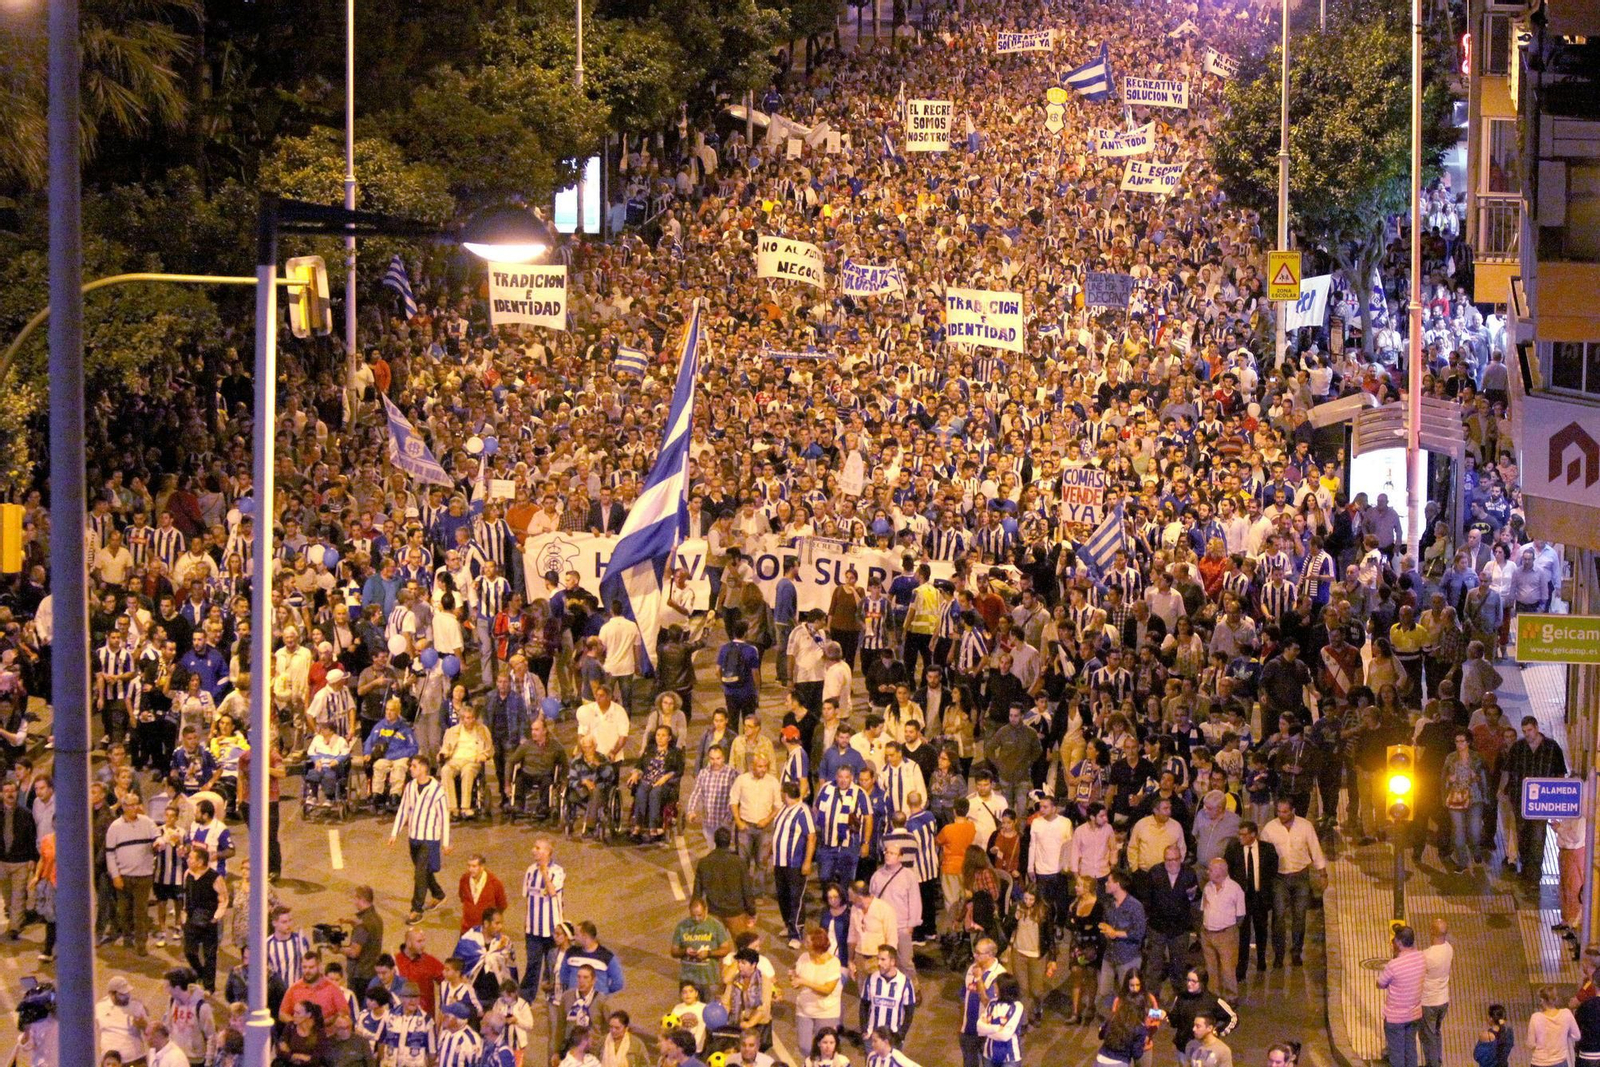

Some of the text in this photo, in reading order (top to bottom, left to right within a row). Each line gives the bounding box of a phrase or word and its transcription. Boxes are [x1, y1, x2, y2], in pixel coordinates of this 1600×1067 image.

[1039, 39, 1050, 48] YA
[1126, 77, 1183, 93] RECREATIVO
[1126, 89, 1183, 104] SOLUCION YA
[909, 103, 951, 116] EL RECRE
[913, 116, 946, 129] SOMOS
[1125, 136, 1146, 148] TODO
[1131, 162, 1142, 174] EL
[761, 242, 778, 252] NO
[784, 245, 799, 255] AL
[493, 272, 565, 289] TRADICION
[525, 289, 533, 300] E
[1088, 291, 1129, 305] DECANO
[493, 299, 561, 316] IDENTIDAD
[948, 322, 1017, 342] IDENTIDAD
[1064, 468, 1104, 489] COMAS
[1062, 485, 1103, 507] VENDE
[1069, 503, 1096, 523] YA
[1540, 786, 1578, 795] ALAMEDA
[1528, 802, 1578, 812] SUNDHEIM
